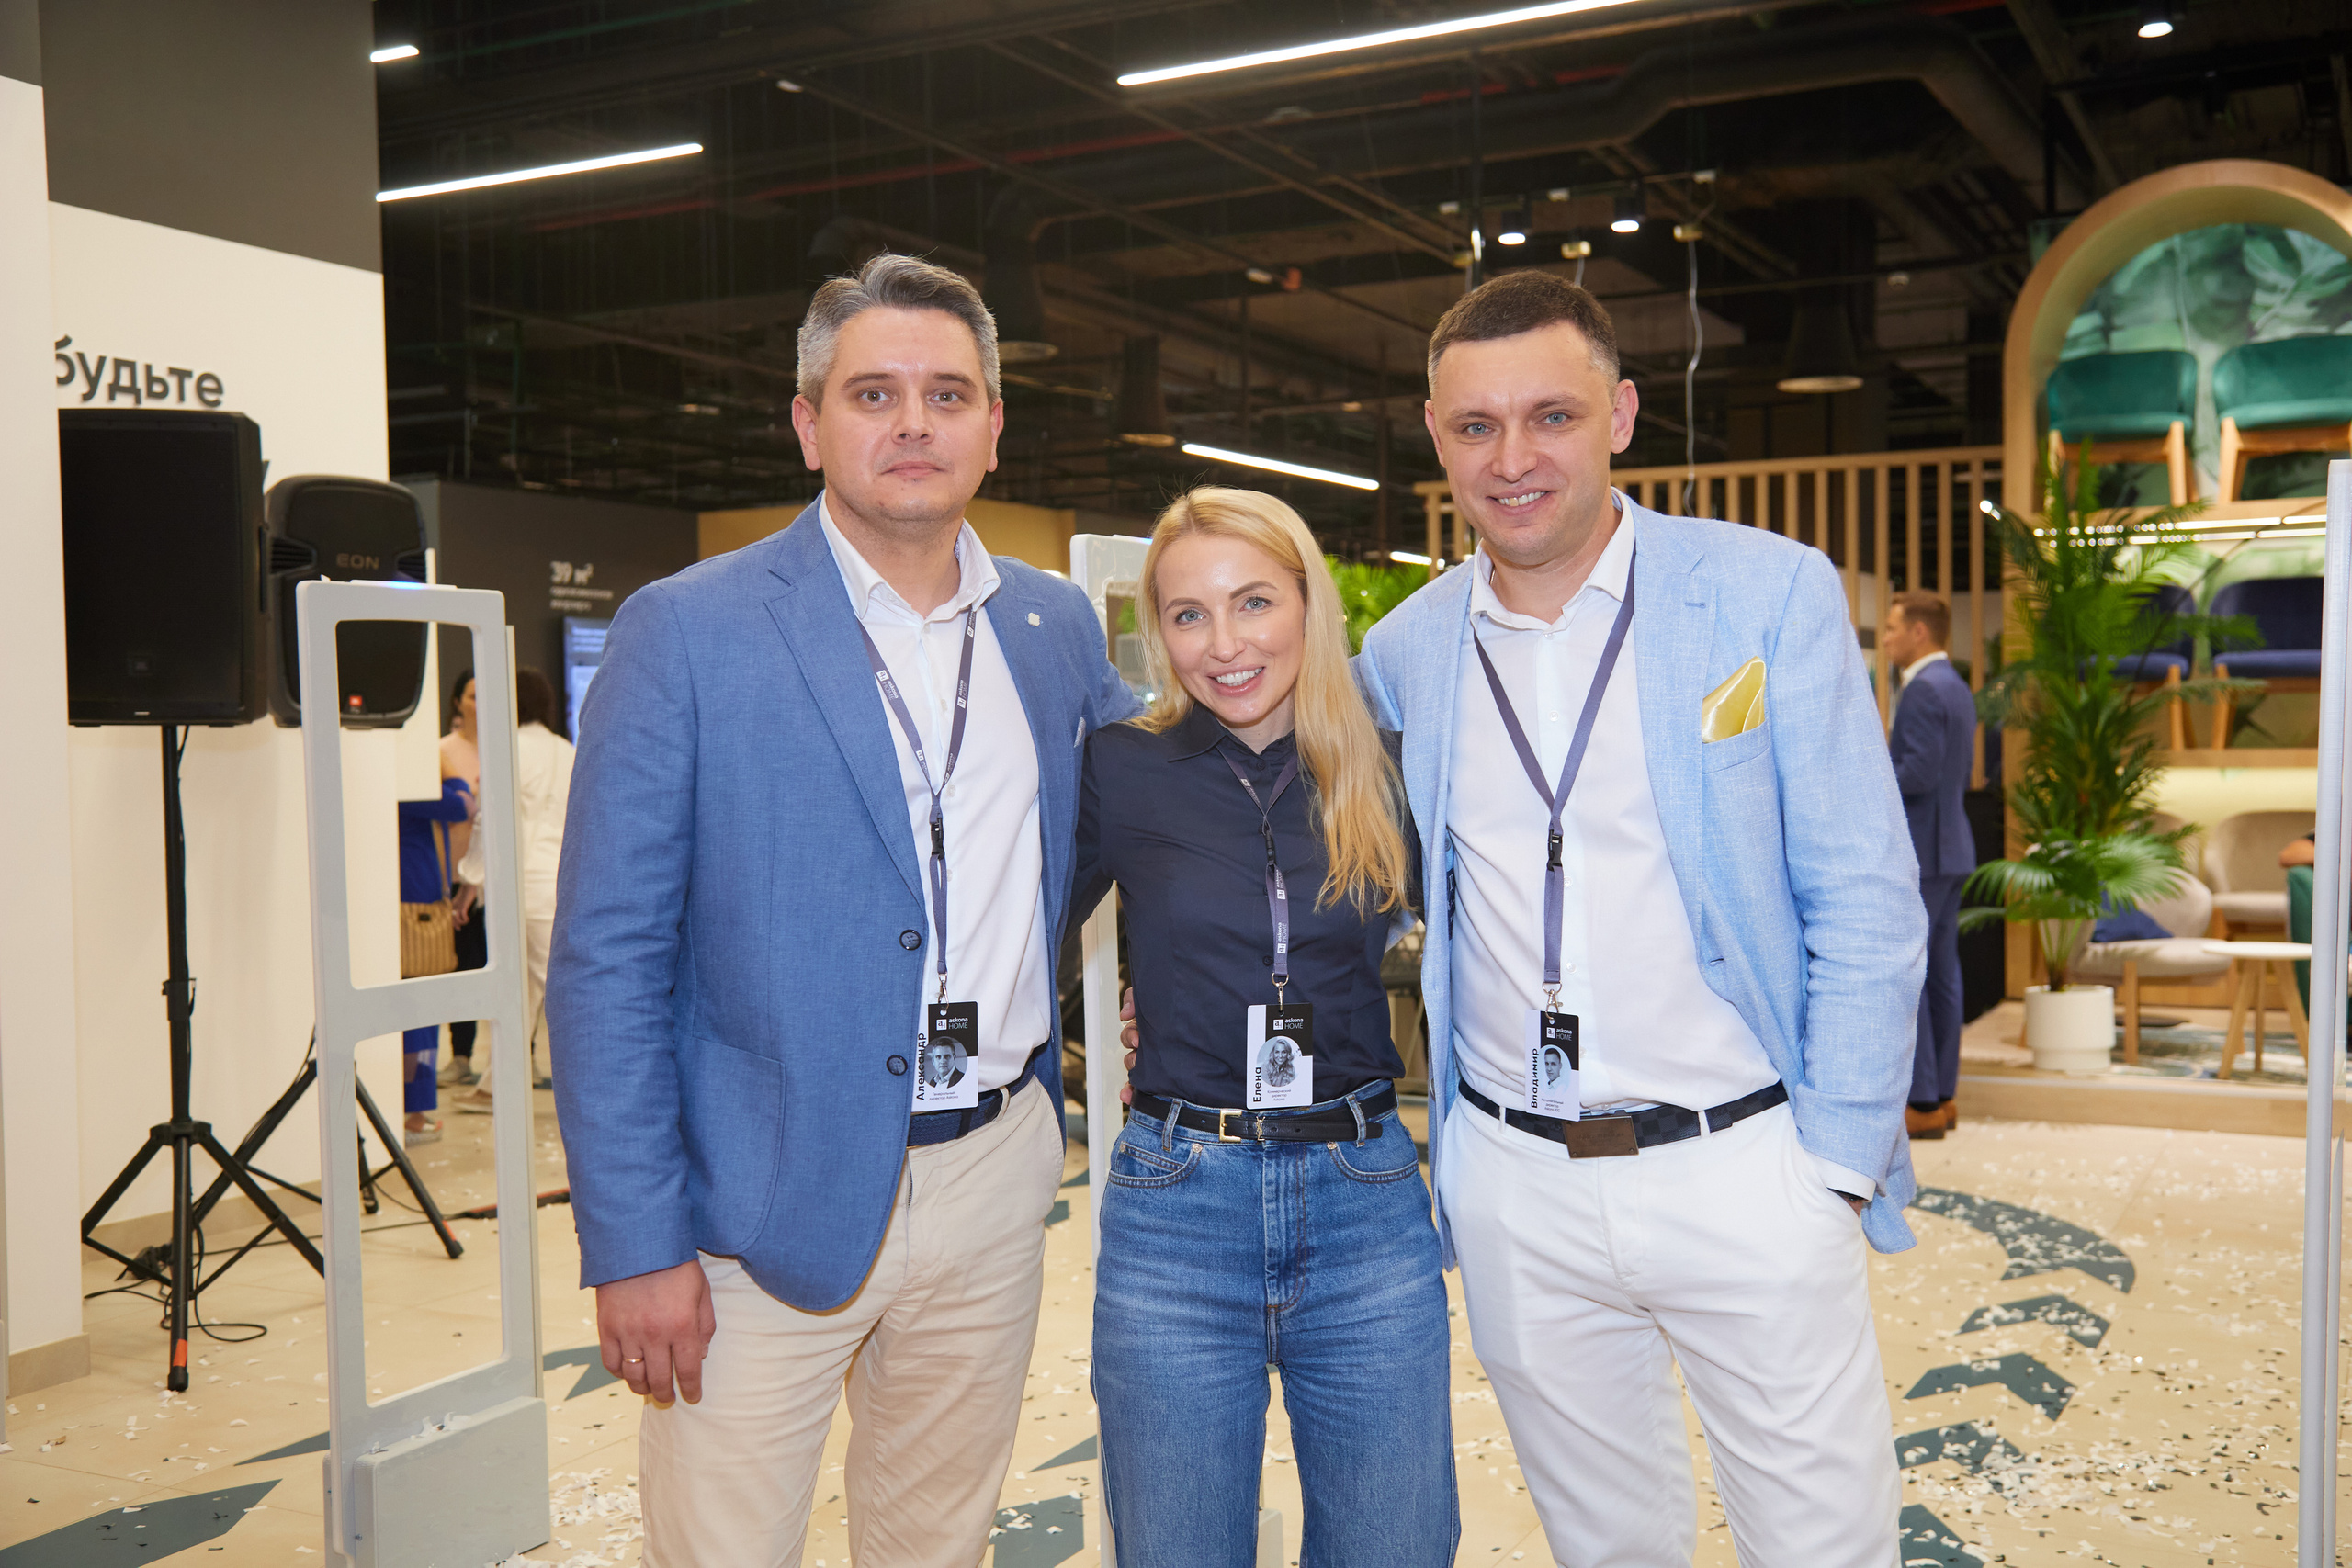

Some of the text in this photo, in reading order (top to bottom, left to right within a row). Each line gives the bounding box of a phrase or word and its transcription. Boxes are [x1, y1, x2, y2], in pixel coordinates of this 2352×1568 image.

[55, 334, 223, 408] будьте
[336, 553, 379, 570] EON
[887, 680, 898, 699] askona
[916, 1032, 926, 1100] Александр
[1253, 1066, 1261, 1102] Елена
[1531, 1048, 1539, 1109] Владимир
